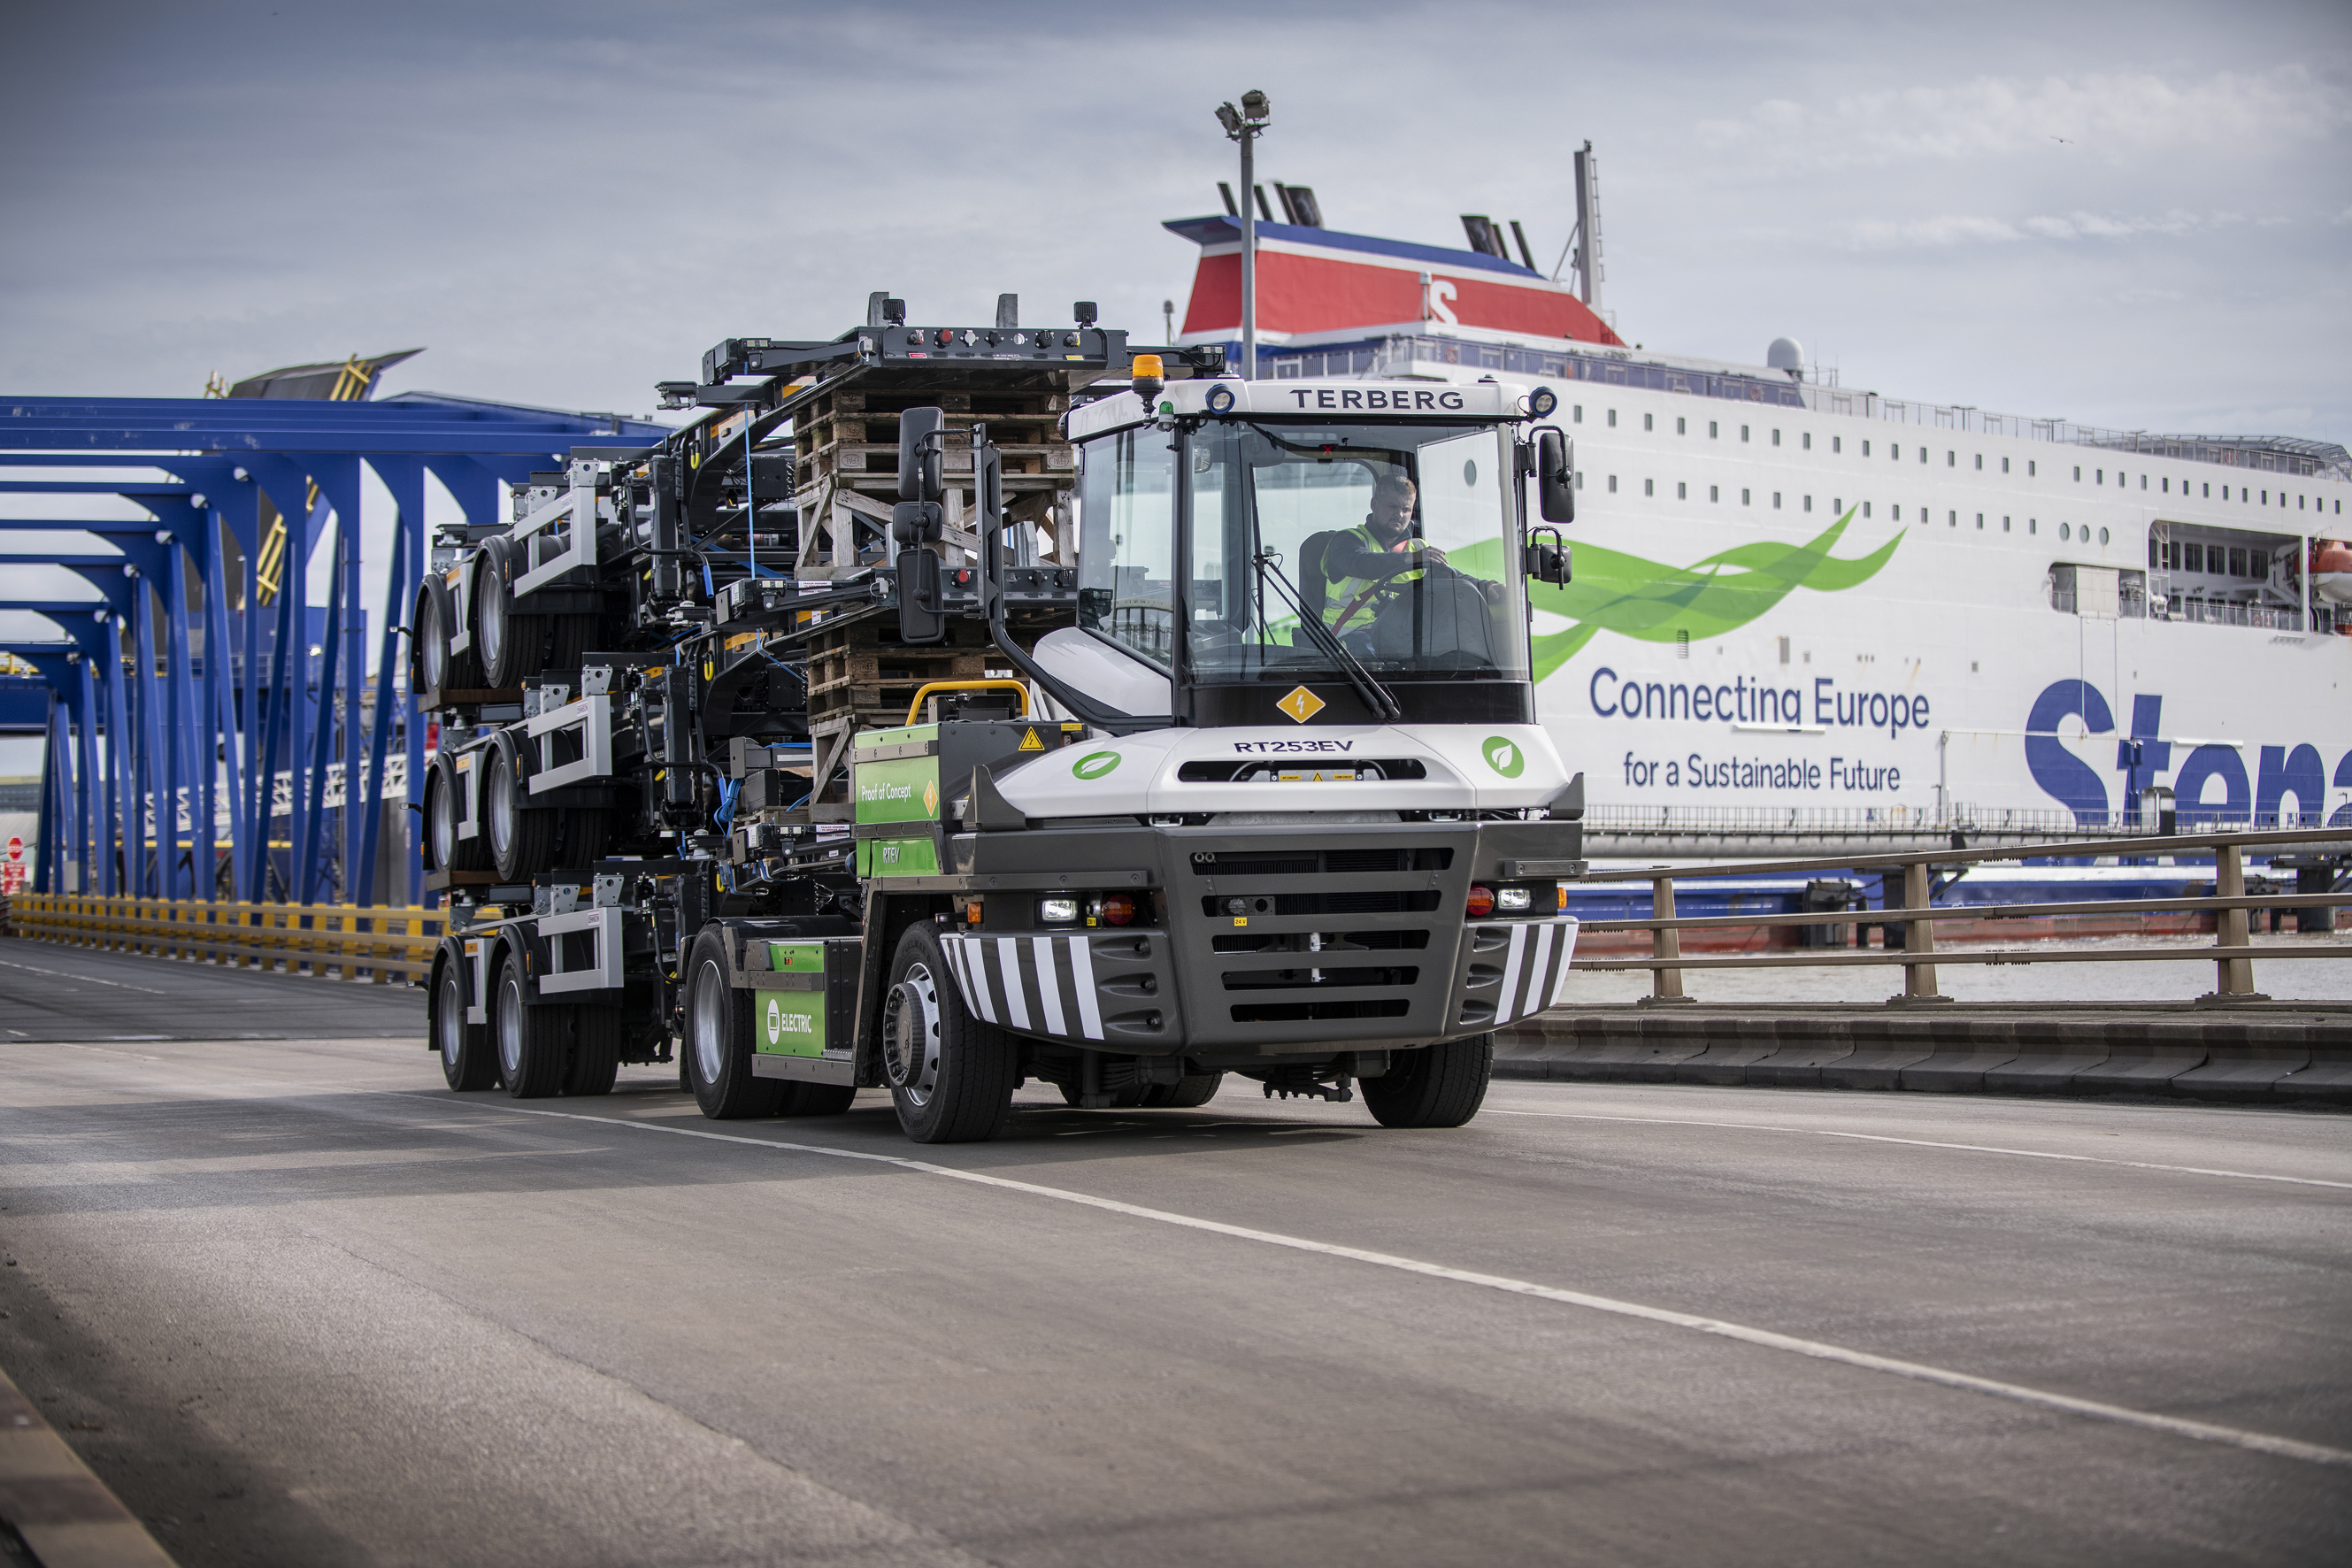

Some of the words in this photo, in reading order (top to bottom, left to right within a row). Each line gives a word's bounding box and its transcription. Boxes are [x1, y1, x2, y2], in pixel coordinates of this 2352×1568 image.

[1289, 389, 1464, 410] TERBERG
[1590, 667, 1802, 733] Connecting
[1815, 678, 1930, 740] Europe
[1234, 741, 1354, 753] RT253EV
[1624, 751, 1658, 787] for
[1666, 762, 1679, 787] a
[1687, 754, 1821, 790] Sustainable
[1830, 757, 1901, 791] Future
[862, 783, 878, 801] Proof
[878, 782, 886, 800] of
[886, 782, 911, 803] Concept
[882, 847, 901, 864] RTEV
[781, 1013, 812, 1034] ELECTRIC
